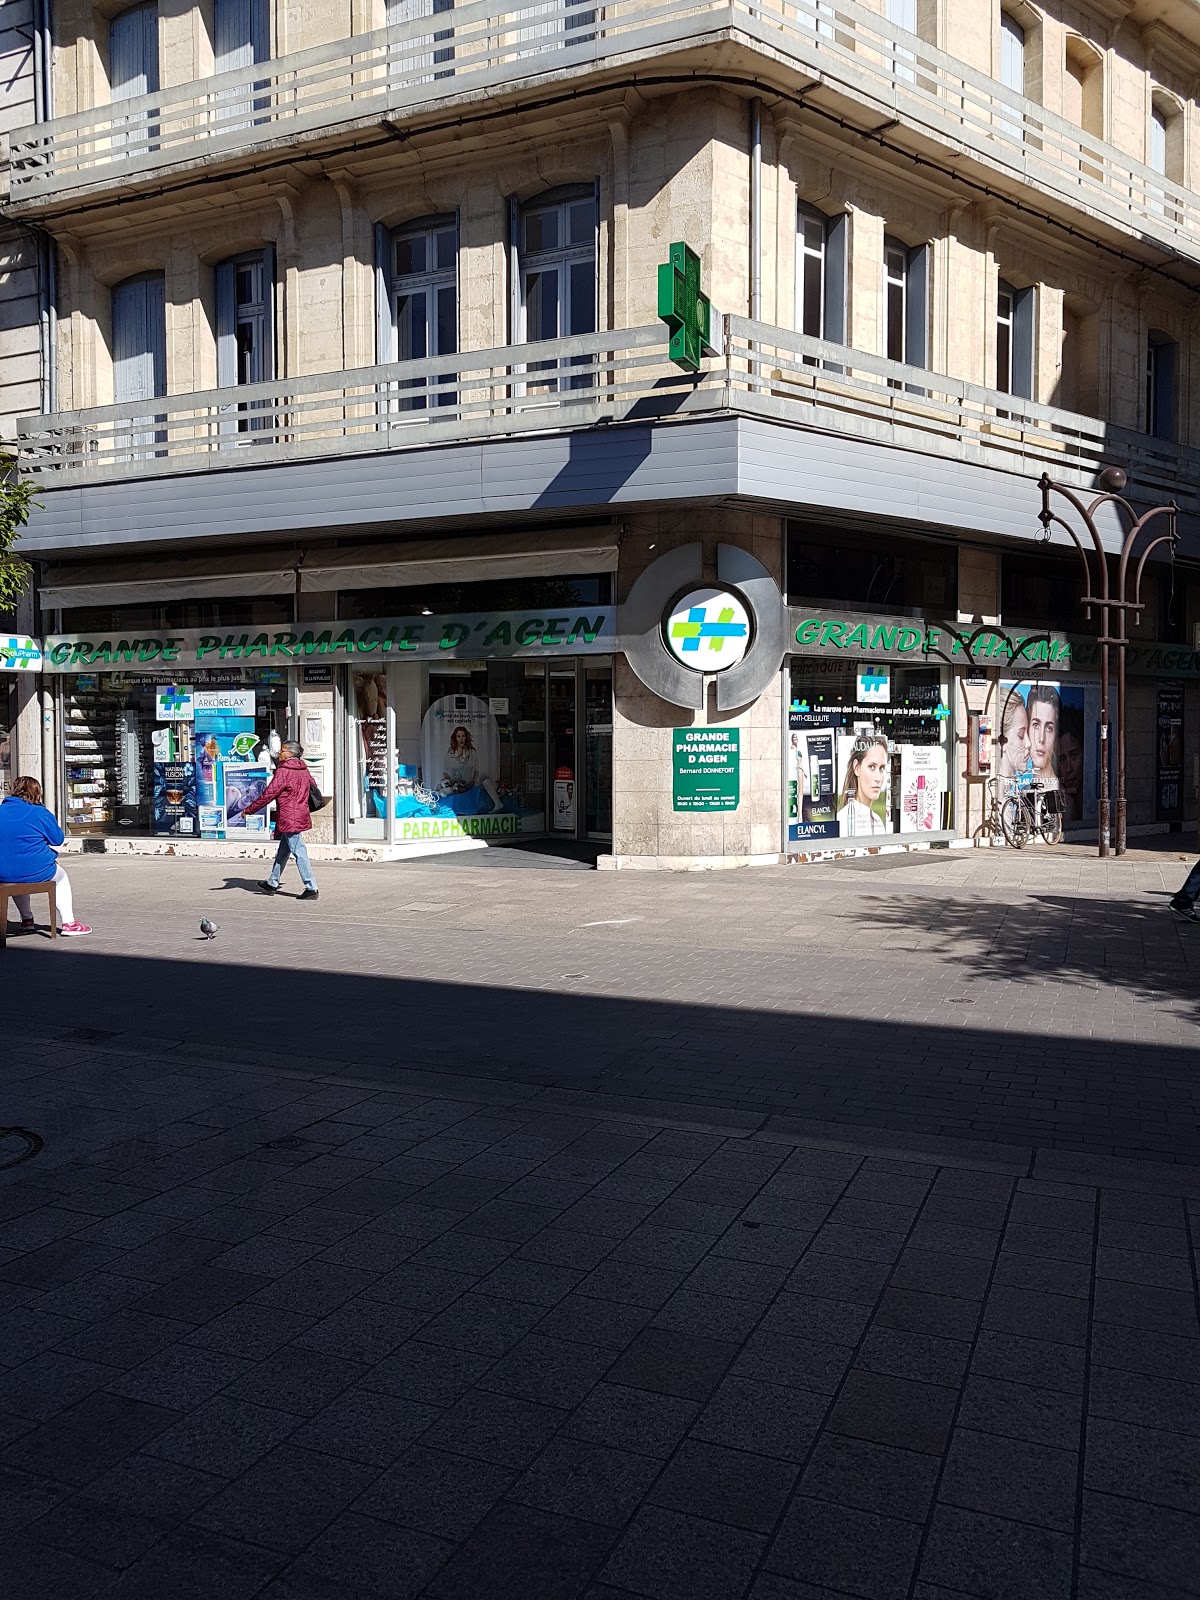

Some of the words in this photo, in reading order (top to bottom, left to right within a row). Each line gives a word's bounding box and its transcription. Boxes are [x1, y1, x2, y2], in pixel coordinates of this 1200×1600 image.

[50, 637, 184, 665] GRANDE
[196, 622, 424, 660] PHARMACIE
[438, 615, 605, 650] D'AGEN
[796, 619, 942, 653] GRANDE
[816, 661, 843, 673] TOUTE
[120, 678, 141, 686] marque
[152, 675, 189, 683] Pharmaciens
[198, 675, 209, 684] prix
[217, 675, 230, 684] plus
[231, 674, 246, 683] juste
[198, 698, 243, 707] ARKORELAX
[159, 711, 191, 719] EvoluPharm
[814, 704, 820, 712] La
[821, 706, 841, 715] marque
[842, 705, 852, 713] des
[853, 705, 885, 714] Pharmaciens
[893, 707, 903, 716] prix
[909, 707, 919, 716] plus
[685, 733, 729, 742] GRANDE
[156, 748, 166, 756] bio
[676, 743, 738, 753] PHARMACIE
[688, 755, 696, 763] D
[698, 755, 728, 763] AGEN
[811, 807, 832, 815] ELANCYL
[403, 816, 523, 839] PARAPHARMACIE
[797, 824, 827, 836] ELANCYL
